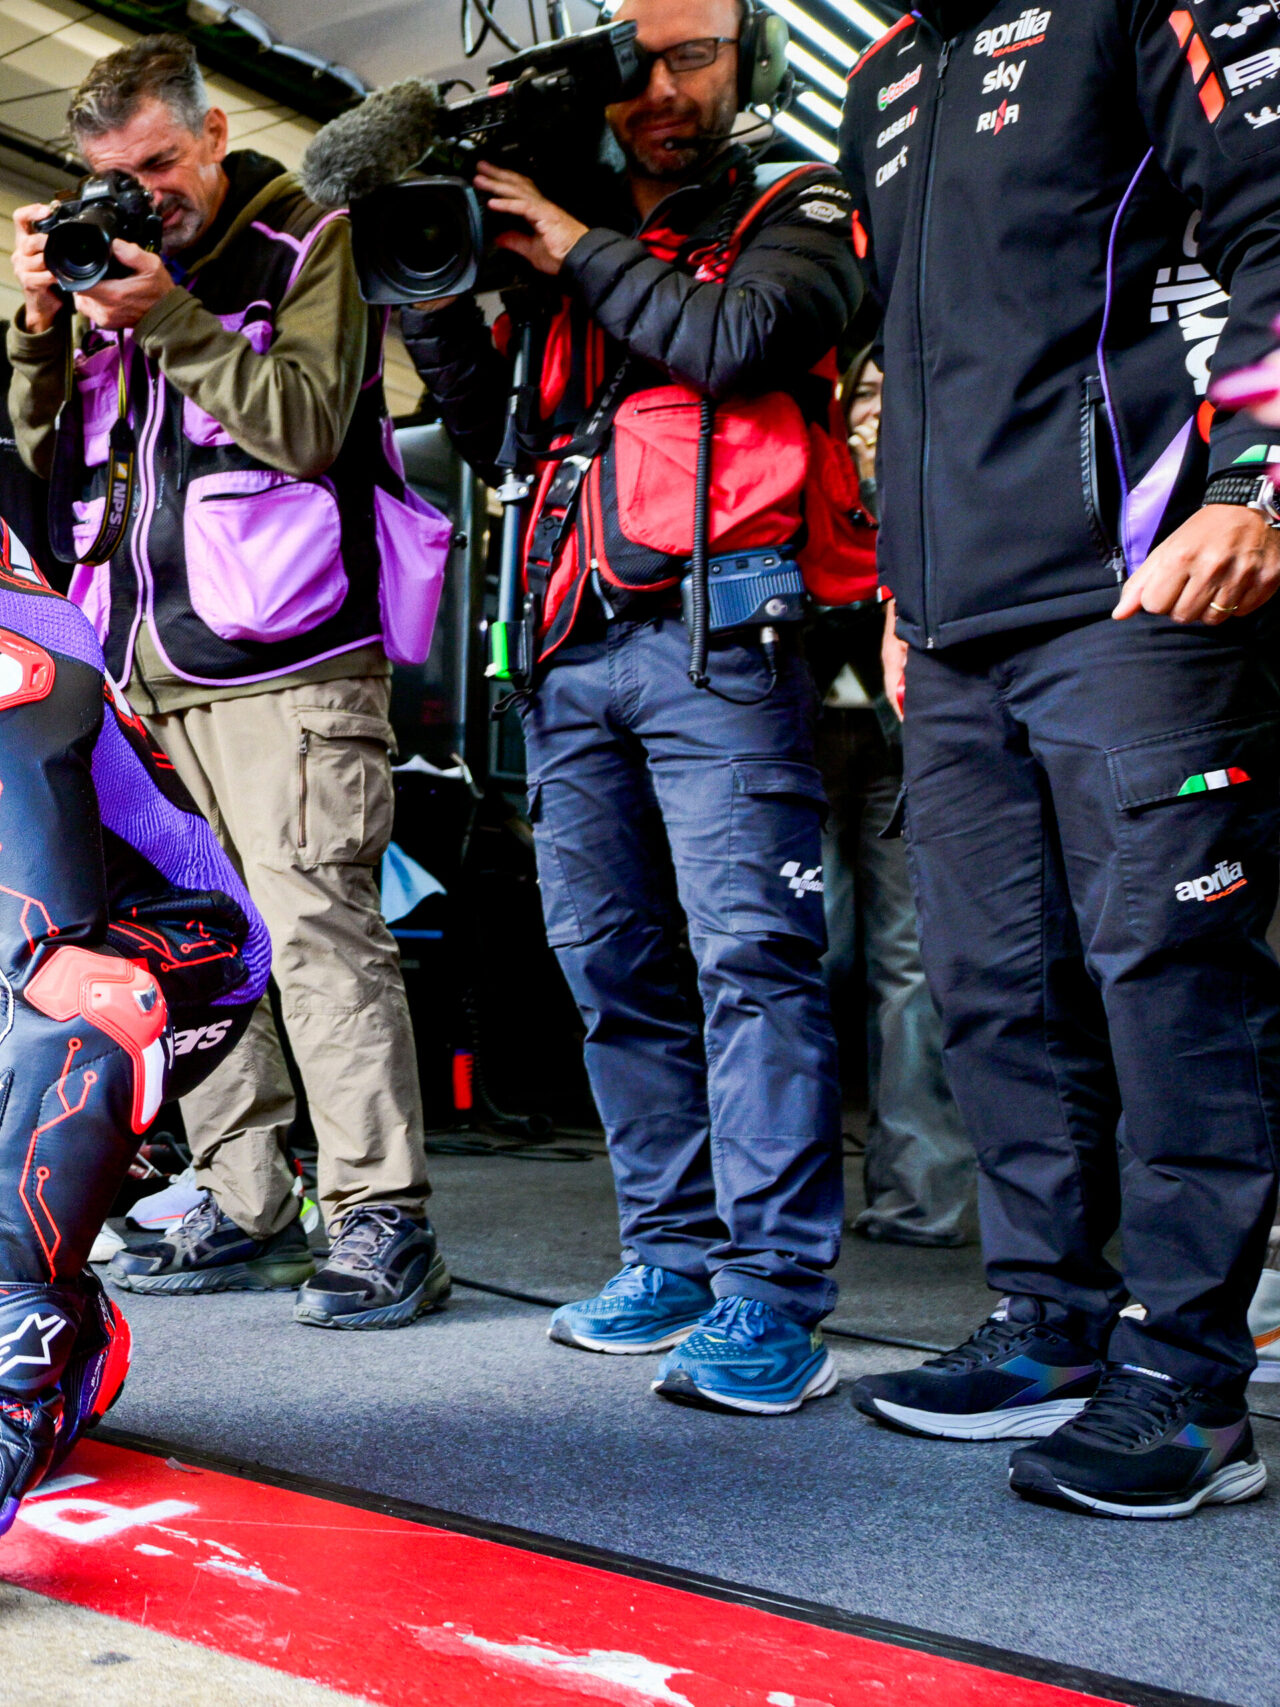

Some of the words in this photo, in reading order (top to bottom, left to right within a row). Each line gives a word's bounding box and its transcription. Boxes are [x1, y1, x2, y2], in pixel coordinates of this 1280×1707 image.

[973, 7, 1052, 57] aprilia
[982, 60, 1027, 94] sky
[109, 481, 127, 526] NPS
[1174, 860, 1244, 902] aprilia
